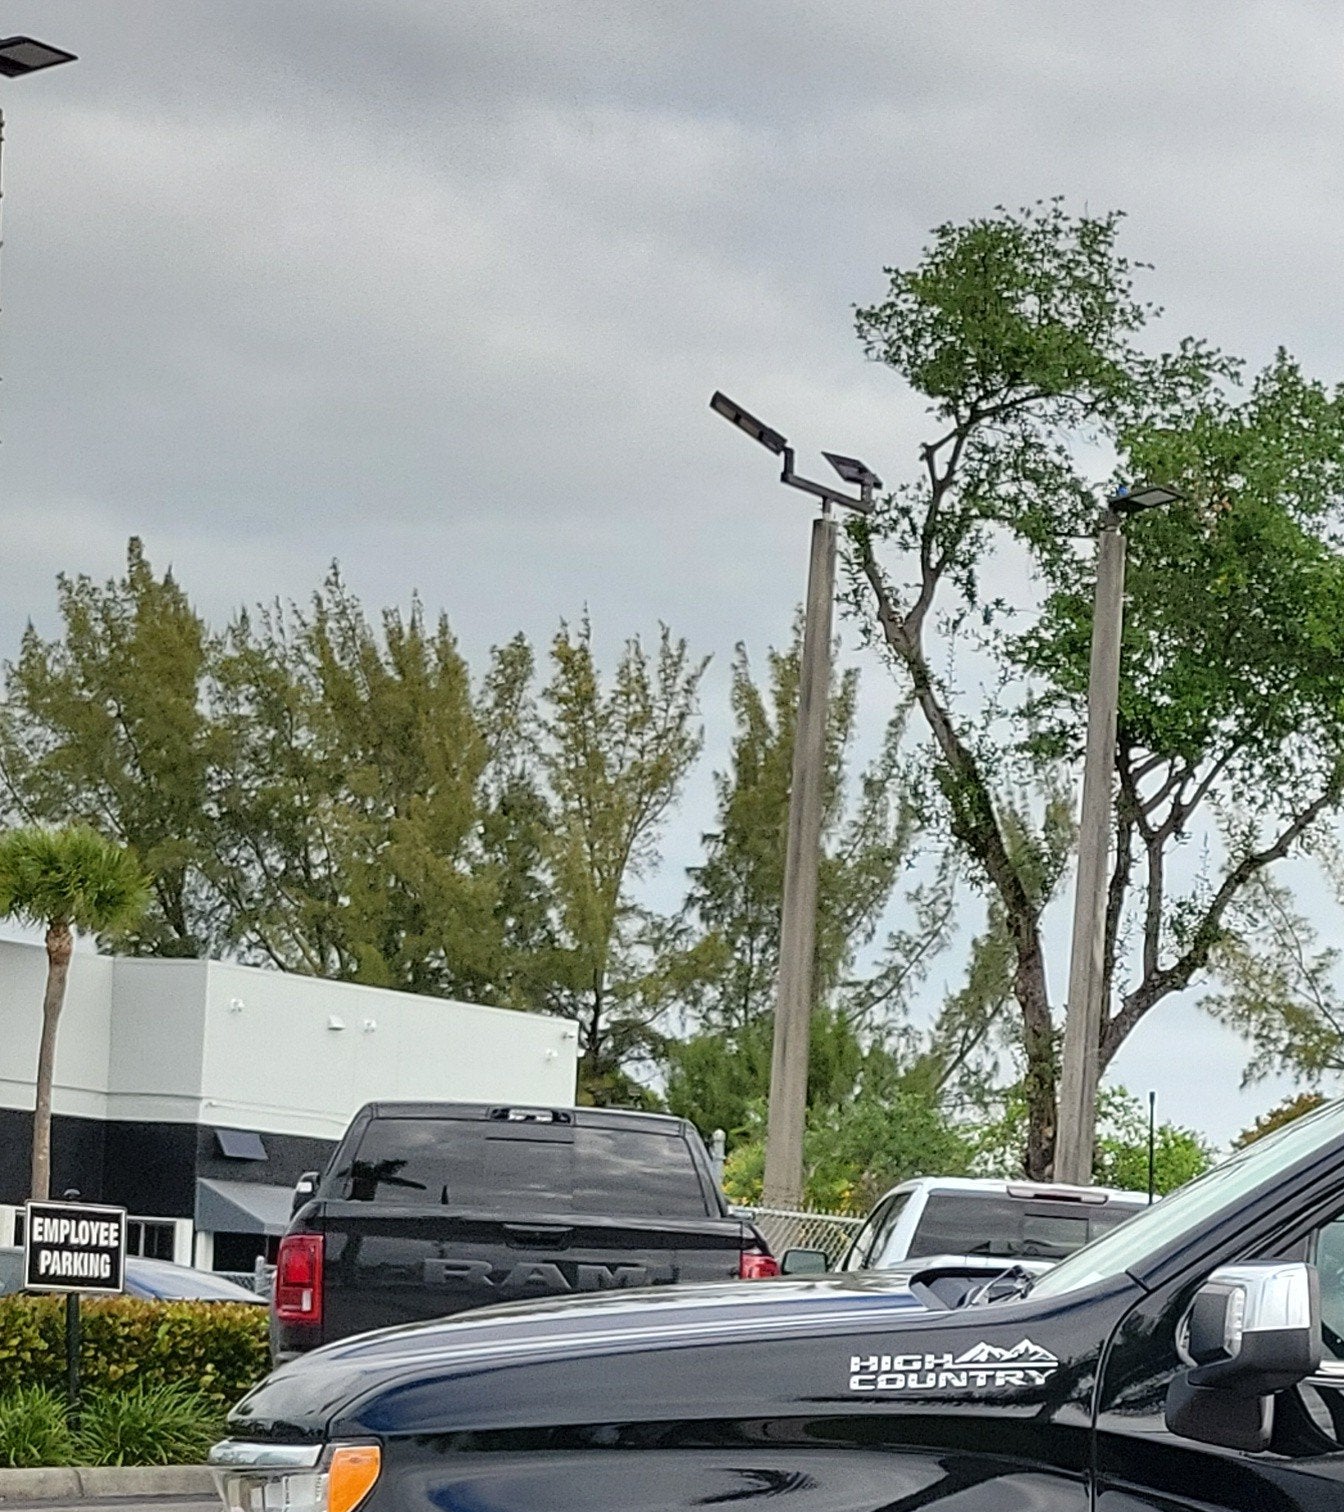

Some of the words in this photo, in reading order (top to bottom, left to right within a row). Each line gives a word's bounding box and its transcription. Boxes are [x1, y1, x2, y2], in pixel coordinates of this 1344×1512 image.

[32, 1217, 119, 1247] EMPLOYEE
[39, 1250, 111, 1279] PARKING
[422, 1257, 647, 1292] RAM
[850, 1353, 954, 1373] HIGH
[849, 1369, 1058, 1391] COUNTRY
